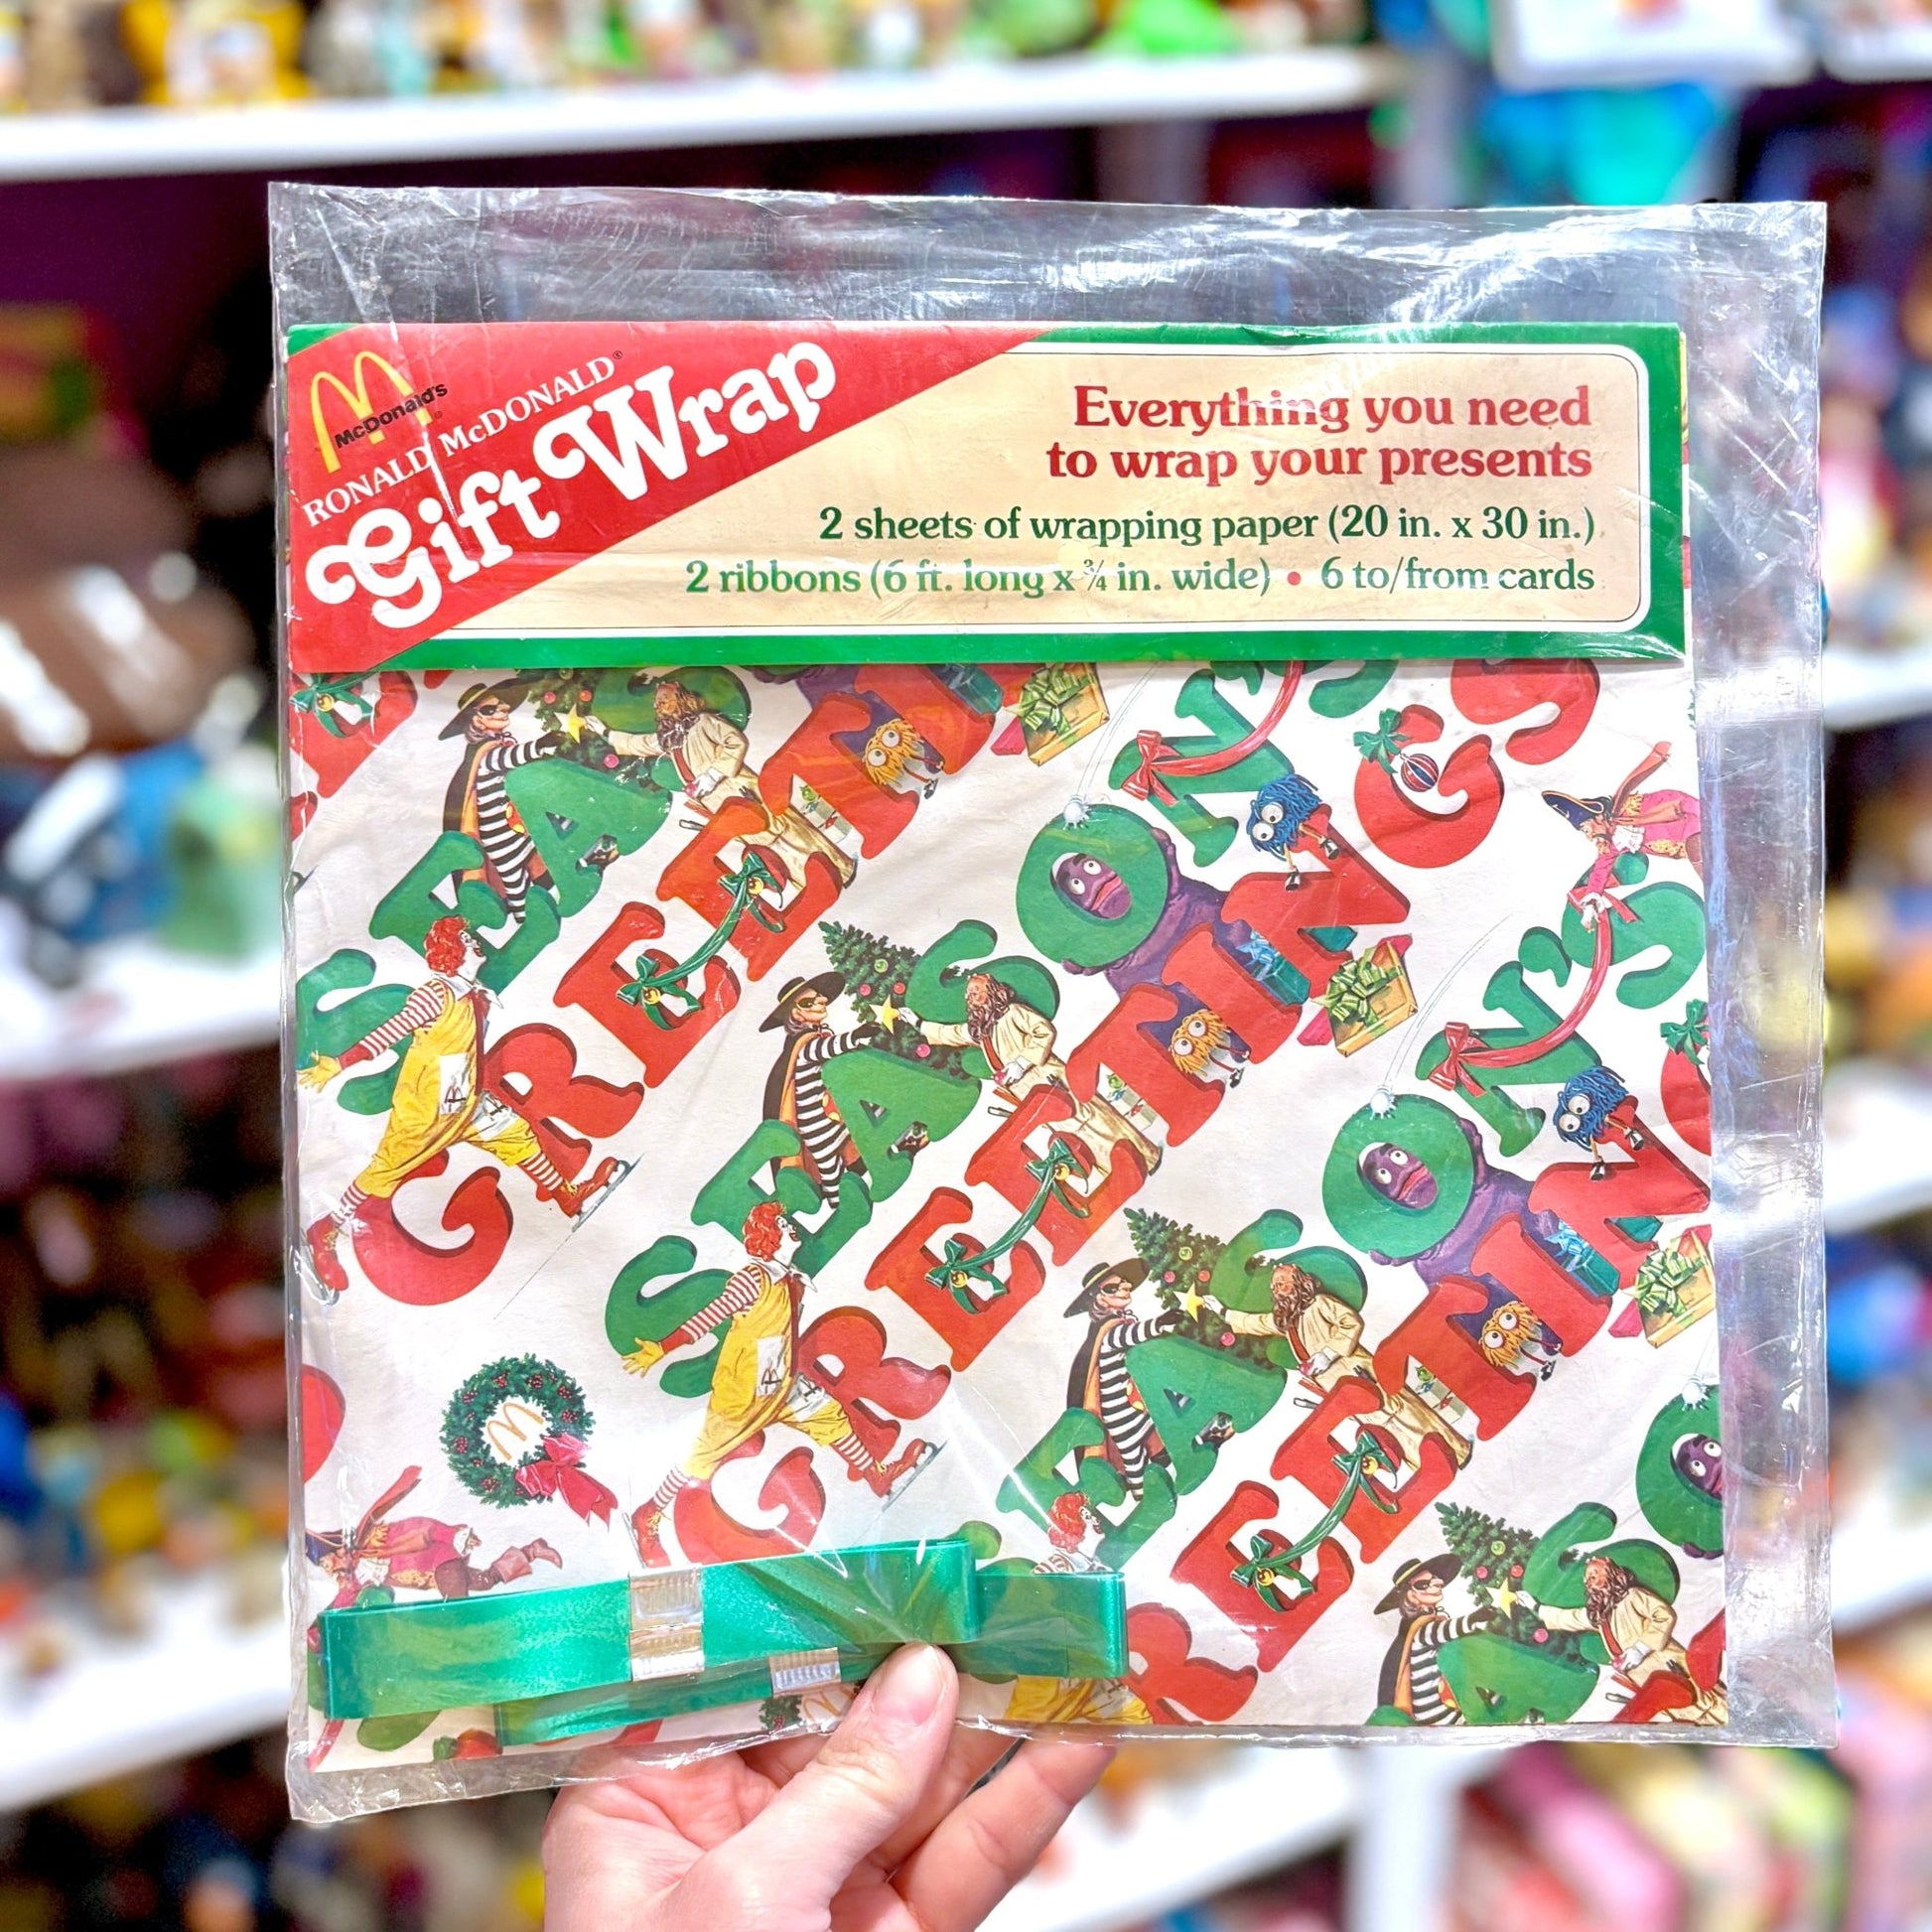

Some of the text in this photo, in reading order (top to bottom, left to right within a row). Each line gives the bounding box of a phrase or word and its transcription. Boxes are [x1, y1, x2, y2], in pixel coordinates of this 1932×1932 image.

[335, 383, 448, 449] McDonald's
[1074, 385, 1590, 435] Everything you need
[302, 446, 432, 527] RONALD
[305, 342, 837, 629] Gift Wrap
[1046, 441, 1592, 487] to wrap your presents
[819, 503, 1595, 547] 2 sheets of wrapping paper (20 in. x 30 in.)
[686, 560, 709, 593] 2
[719, 559, 861, 594] ribbons
[870, 559, 906, 600] (6
[915, 559, 953, 592] ft.
[963, 558, 1044, 599] long
[1053, 570, 1075, 593] x
[1117, 560, 1162, 593] in.
[1172, 557, 1271, 596] wide)
[1320, 556, 1343, 590] 6
[1352, 556, 1489, 595] to/from
[1498, 558, 1594, 590] cards
